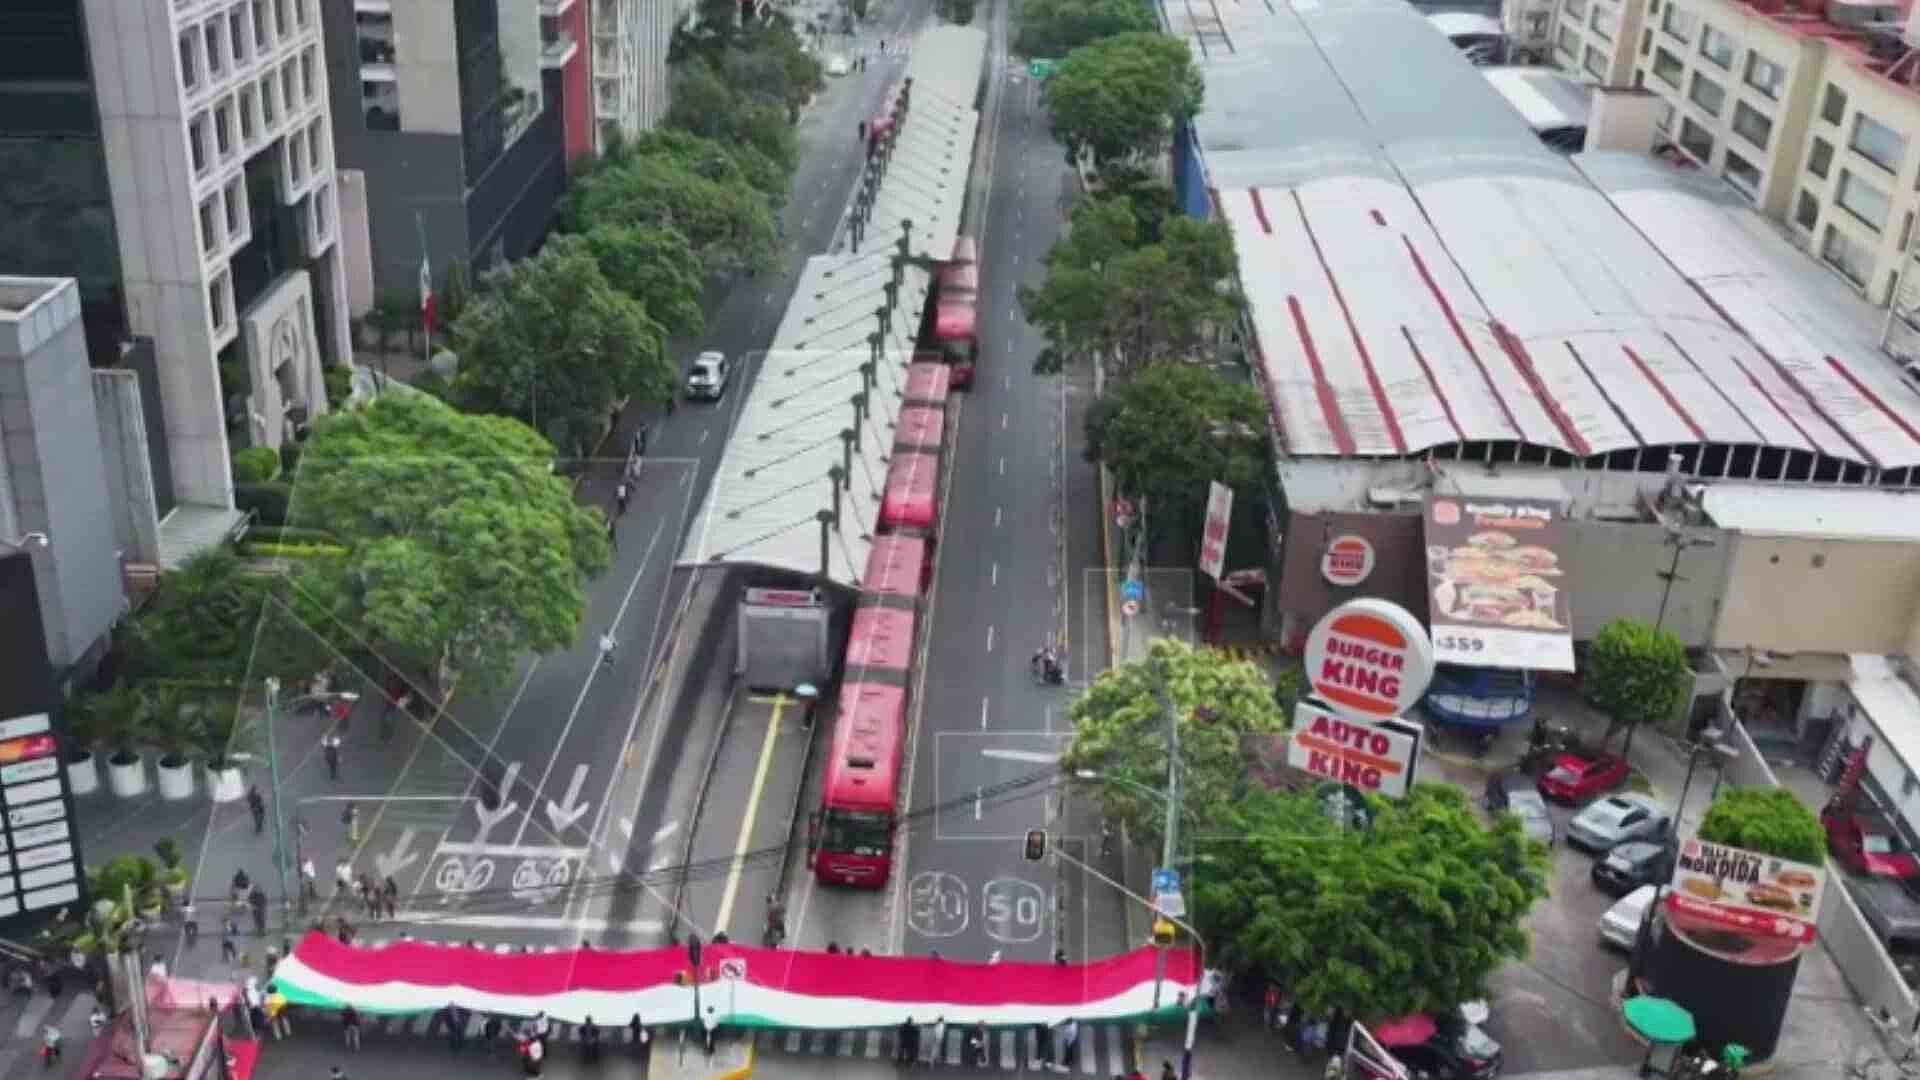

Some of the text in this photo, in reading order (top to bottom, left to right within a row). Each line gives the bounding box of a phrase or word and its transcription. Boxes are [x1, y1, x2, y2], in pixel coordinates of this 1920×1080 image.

[1326, 637, 1404, 673] BURGER
[1322, 658, 1400, 699] KING
[1311, 716, 1390, 756] AUTO
[1308, 750, 1382, 789] KING
[988, 895, 1037, 924] 50
